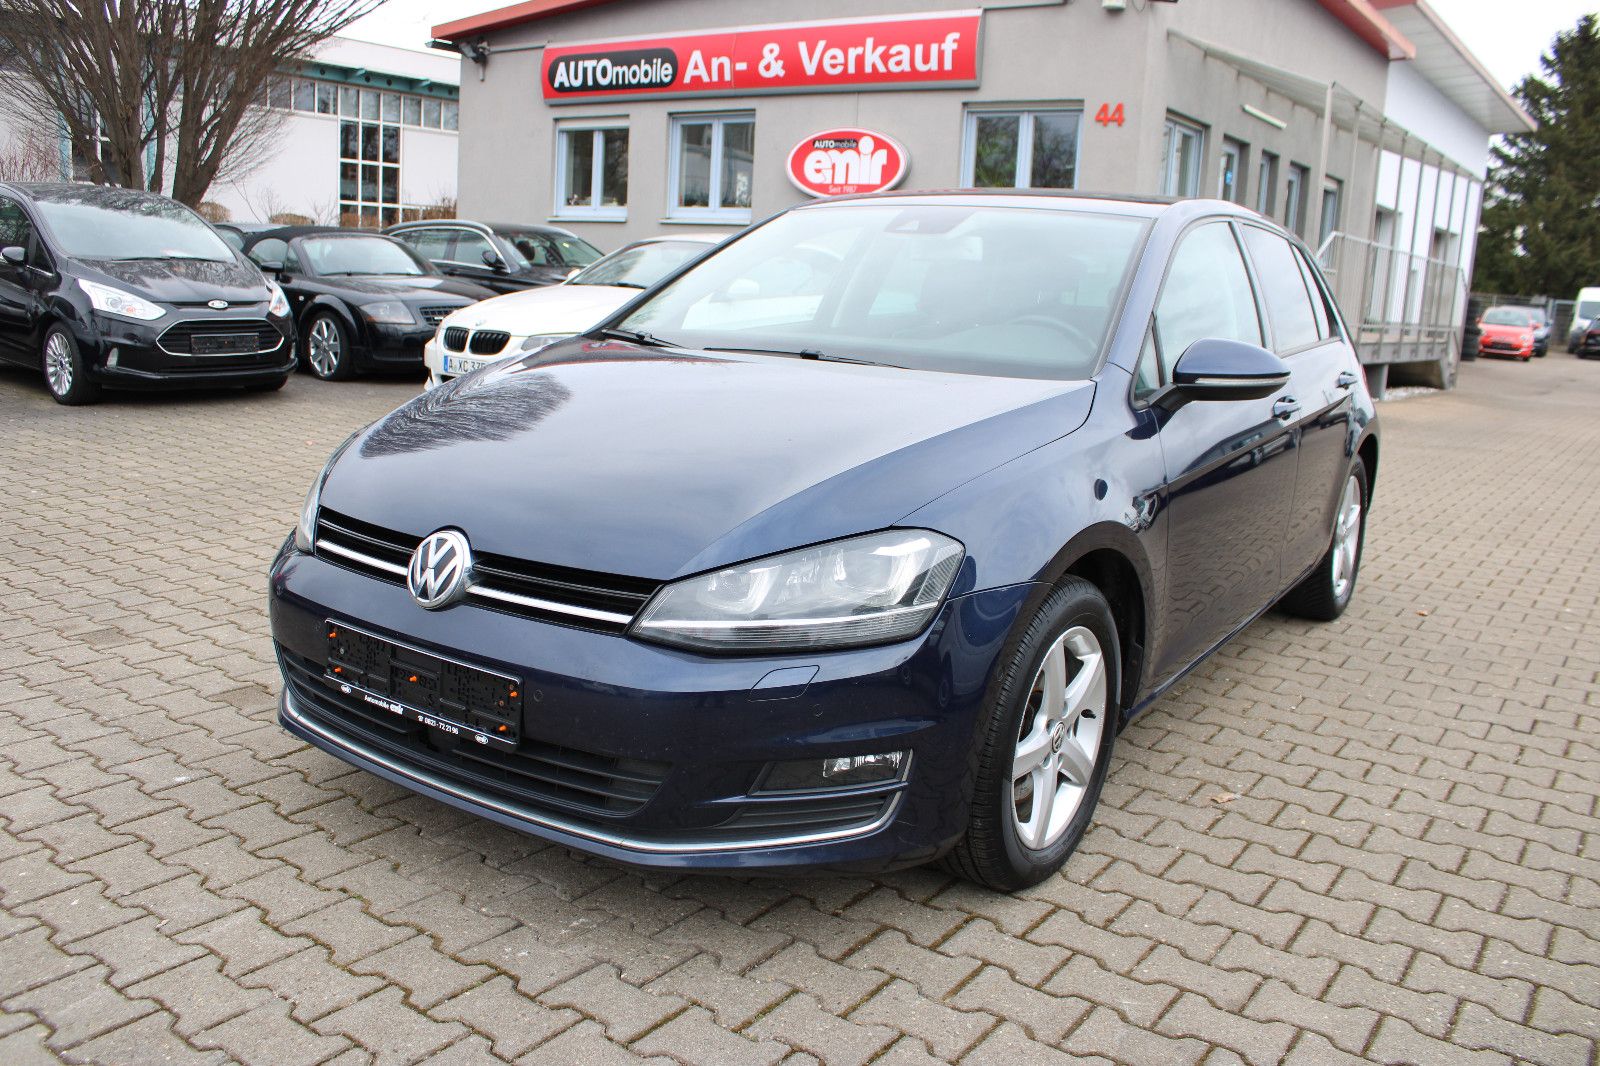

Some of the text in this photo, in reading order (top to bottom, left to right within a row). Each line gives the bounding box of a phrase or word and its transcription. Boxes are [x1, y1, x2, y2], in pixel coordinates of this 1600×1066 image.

[553, 32, 960, 90] AUTOmobile An- & Verkauf
[1095, 103, 1126, 127] 44
[814, 140, 858, 149] AUTOmobile
[804, 136, 888, 185] emir
[828, 185, 858, 193] Seit 1987
